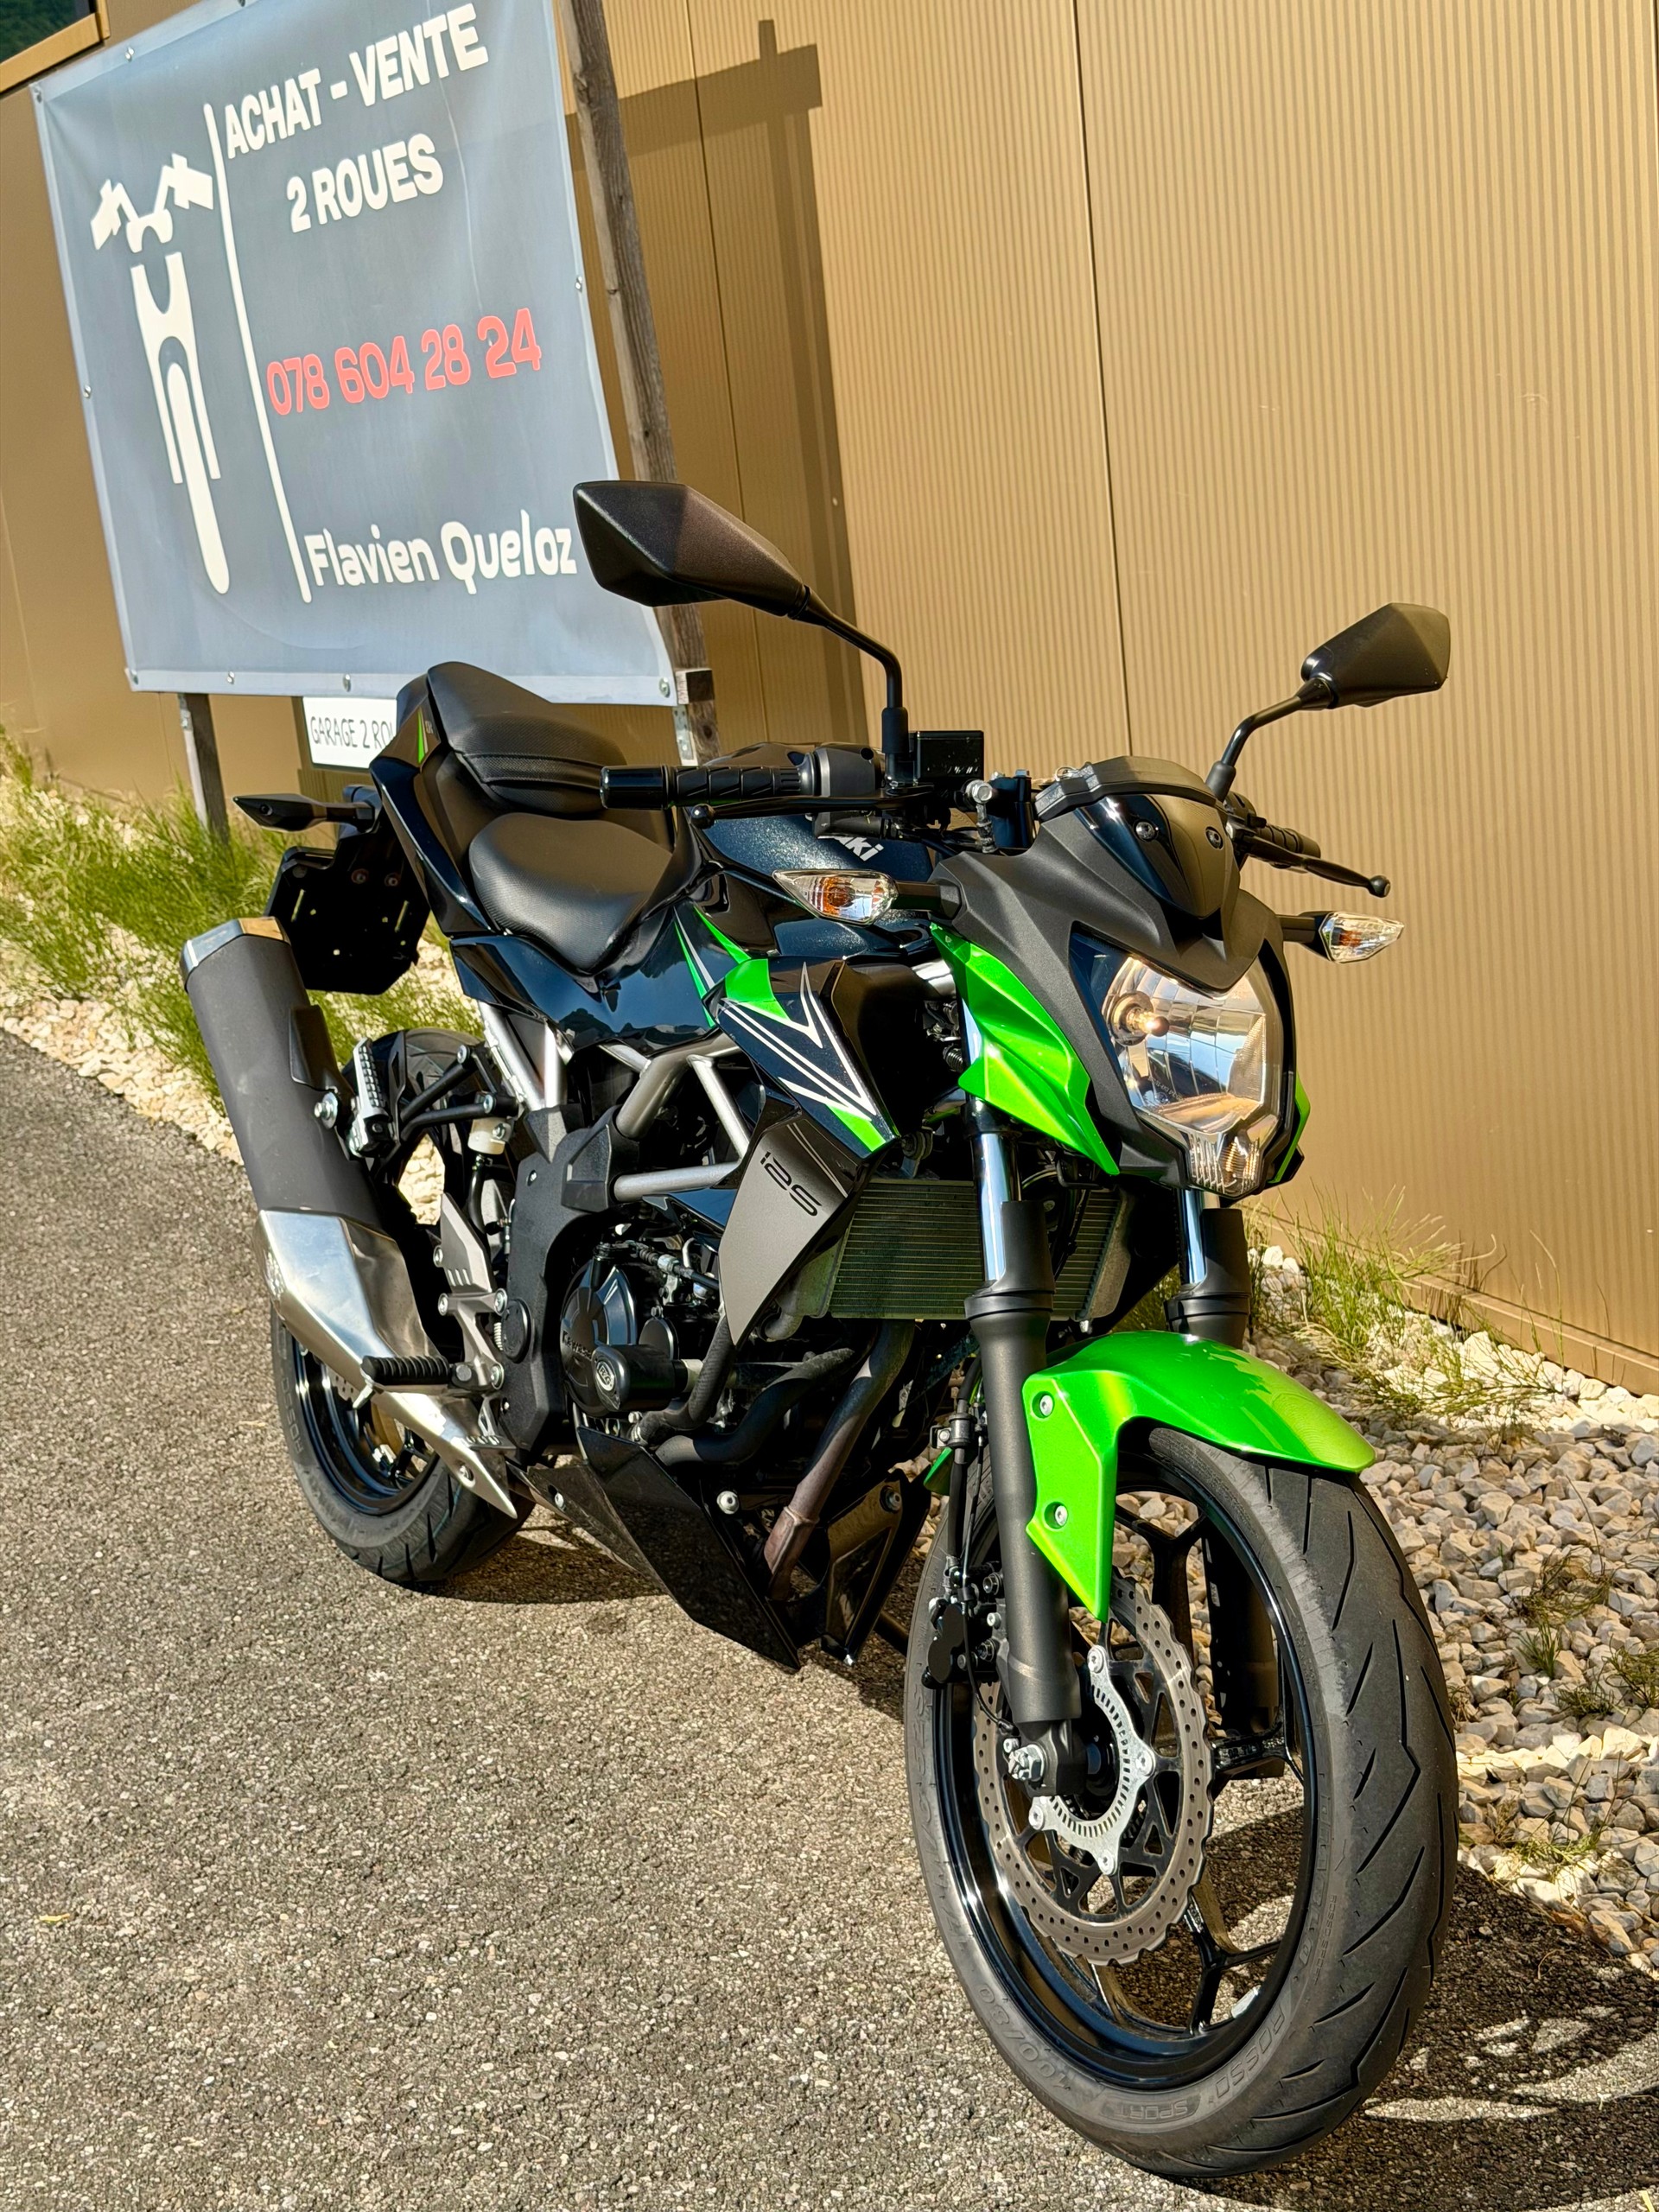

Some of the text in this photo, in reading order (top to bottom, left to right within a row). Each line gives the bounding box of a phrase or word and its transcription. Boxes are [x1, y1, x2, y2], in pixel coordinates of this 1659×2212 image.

[225, 3, 489, 159] ACHAT - VENTE
[286, 133, 444, 233] 2 ROUES
[266, 308, 542, 416] 078 604 28 24
[303, 509, 577, 594] Flavien Queloz
[310, 715, 358, 748] GARAGE
[359, 719, 371, 749] 2
[760, 1151, 823, 1217] 125
[280, 1376, 303, 1454] ROSSO
[978, 1983, 1069, 2089] 100/80
[1113, 2004, 1286, 2120] ROSSO SPORT
